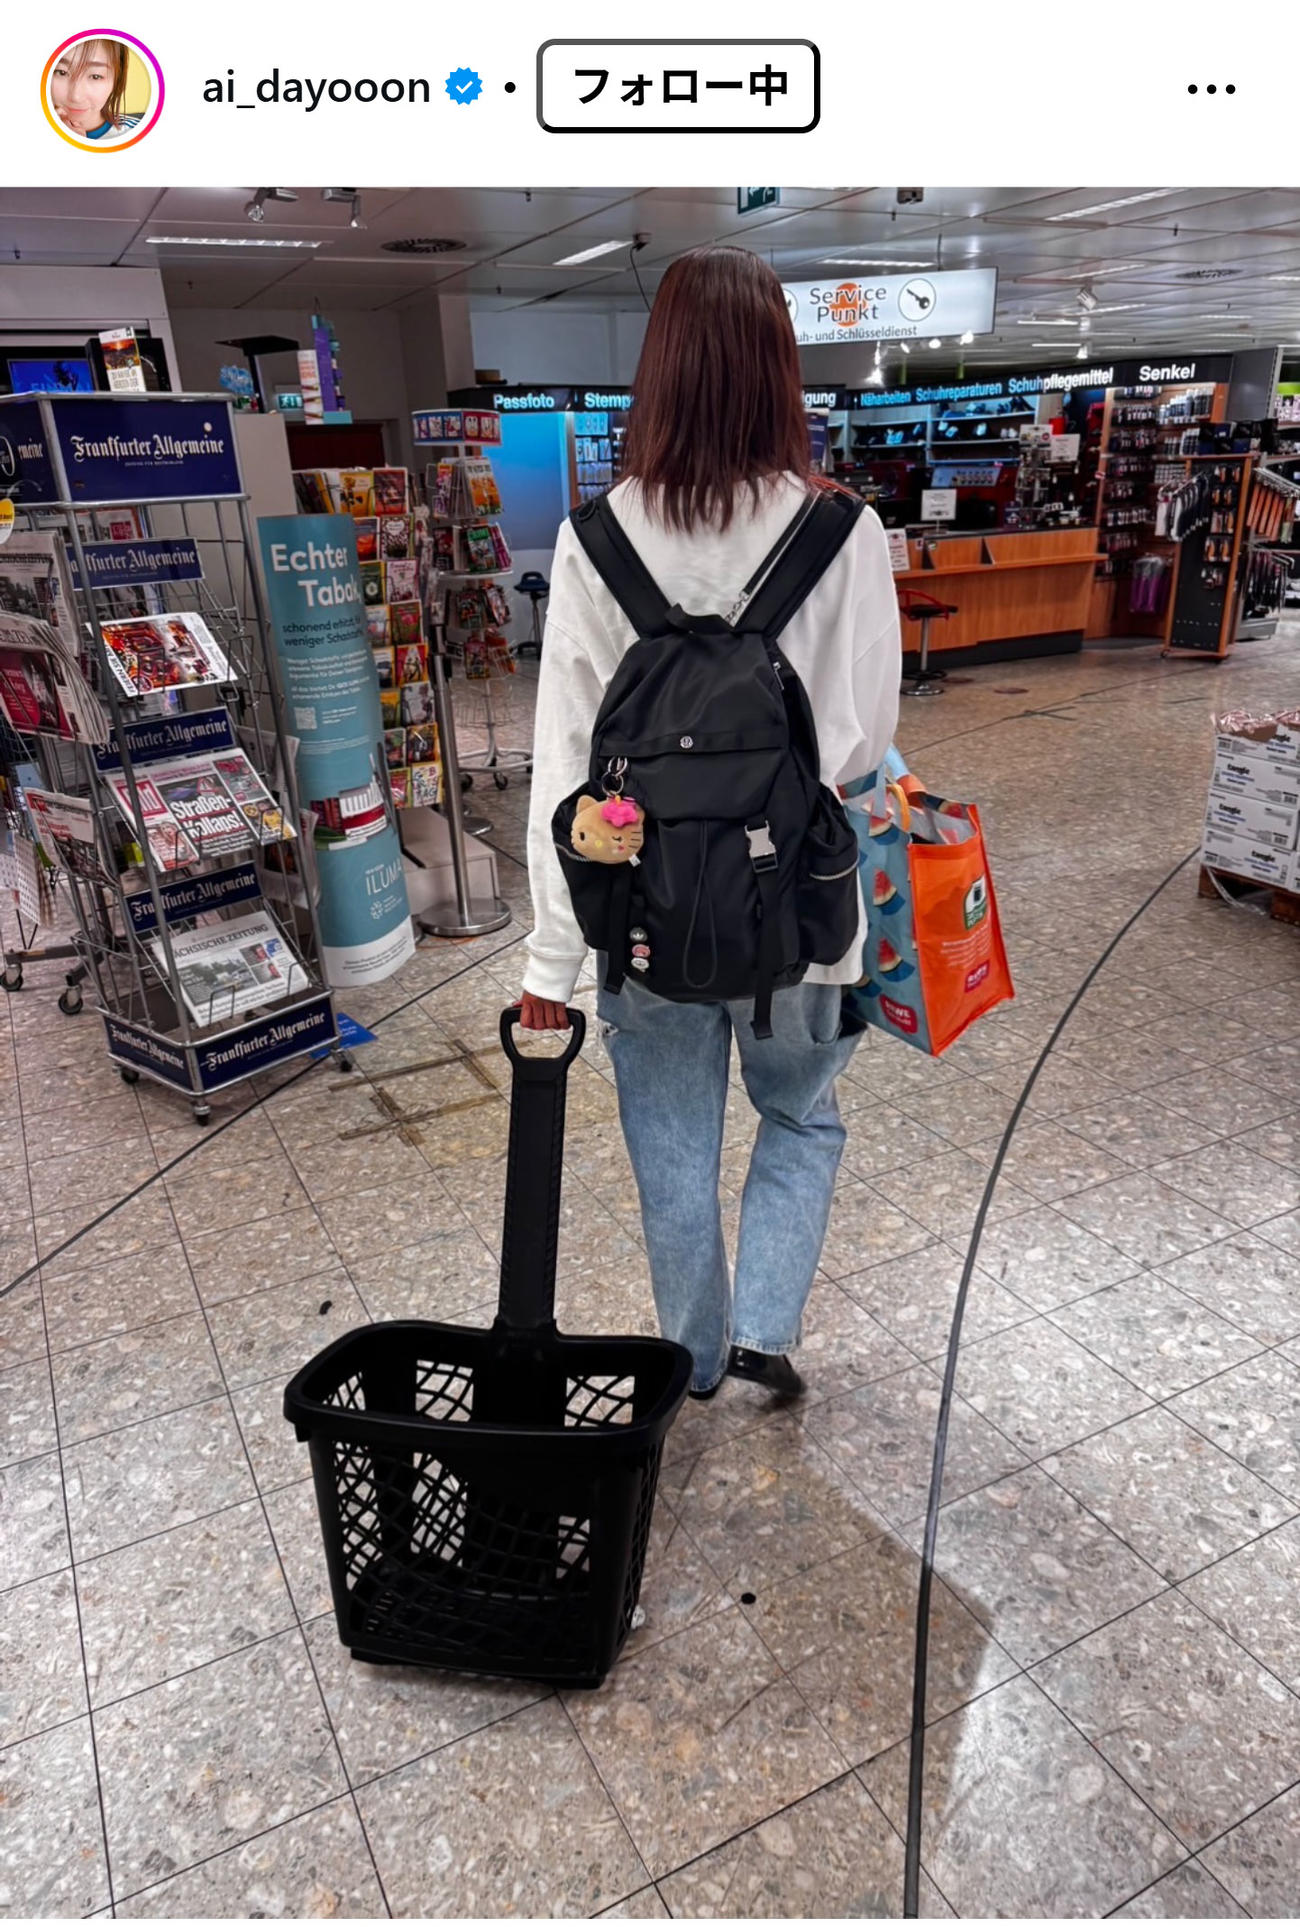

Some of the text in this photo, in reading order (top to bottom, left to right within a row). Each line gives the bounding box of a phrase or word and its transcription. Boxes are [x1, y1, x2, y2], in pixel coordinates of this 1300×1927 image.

[810, 284, 887, 304] Service
[817, 304, 879, 323] Punkt
[796, 326, 917, 342] uh- und Schlüsseldienst
[915, 381, 1002, 402] Schuhreparaturen
[1008, 366, 1113, 394] Schuhpflegemittel
[1139, 363, 1196, 382] Senkel
[493, 394, 555, 410] Passfoto
[584, 392, 631, 410] Stemp
[801, 389, 837, 408] igung
[71, 434, 224, 463] Frankfurter Allgemeine
[127, 547, 196, 573] Allgemeine
[270, 541, 348, 573] Echter
[282, 619, 332, 633] schonend
[284, 635, 325, 648] weniger
[96, 717, 228, 760] Frakfurter Allgemeine
[169, 793, 232, 820] Straßen-
[182, 810, 245, 840] Kollaps!
[130, 871, 256, 922] Frakfurter Allgemeine
[226, 923, 270, 944] ZEITUNG
[206, 1032, 269, 1072] Frankfurter
[267, 1012, 326, 1047] Allgemeine
